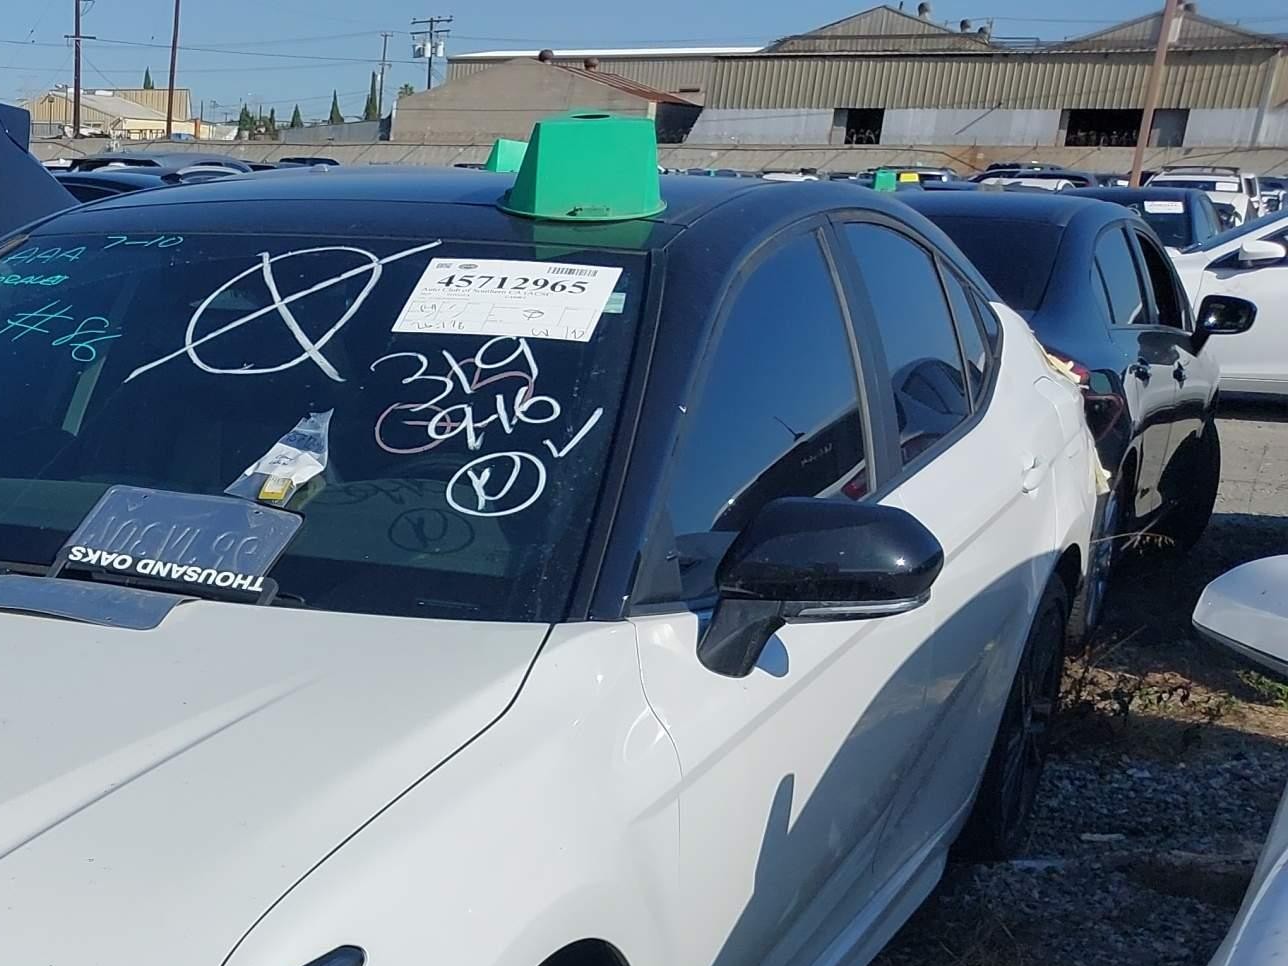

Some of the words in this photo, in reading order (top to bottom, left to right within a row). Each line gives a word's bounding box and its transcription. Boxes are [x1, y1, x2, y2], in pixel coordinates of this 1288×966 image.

[1, 246, 87, 264] AAA
[103, 235, 184, 249] 7-10
[437, 273, 590, 295] 45712965
[68, 545, 133, 570] OAKS
[137, 553, 265, 592] THOUSAND
